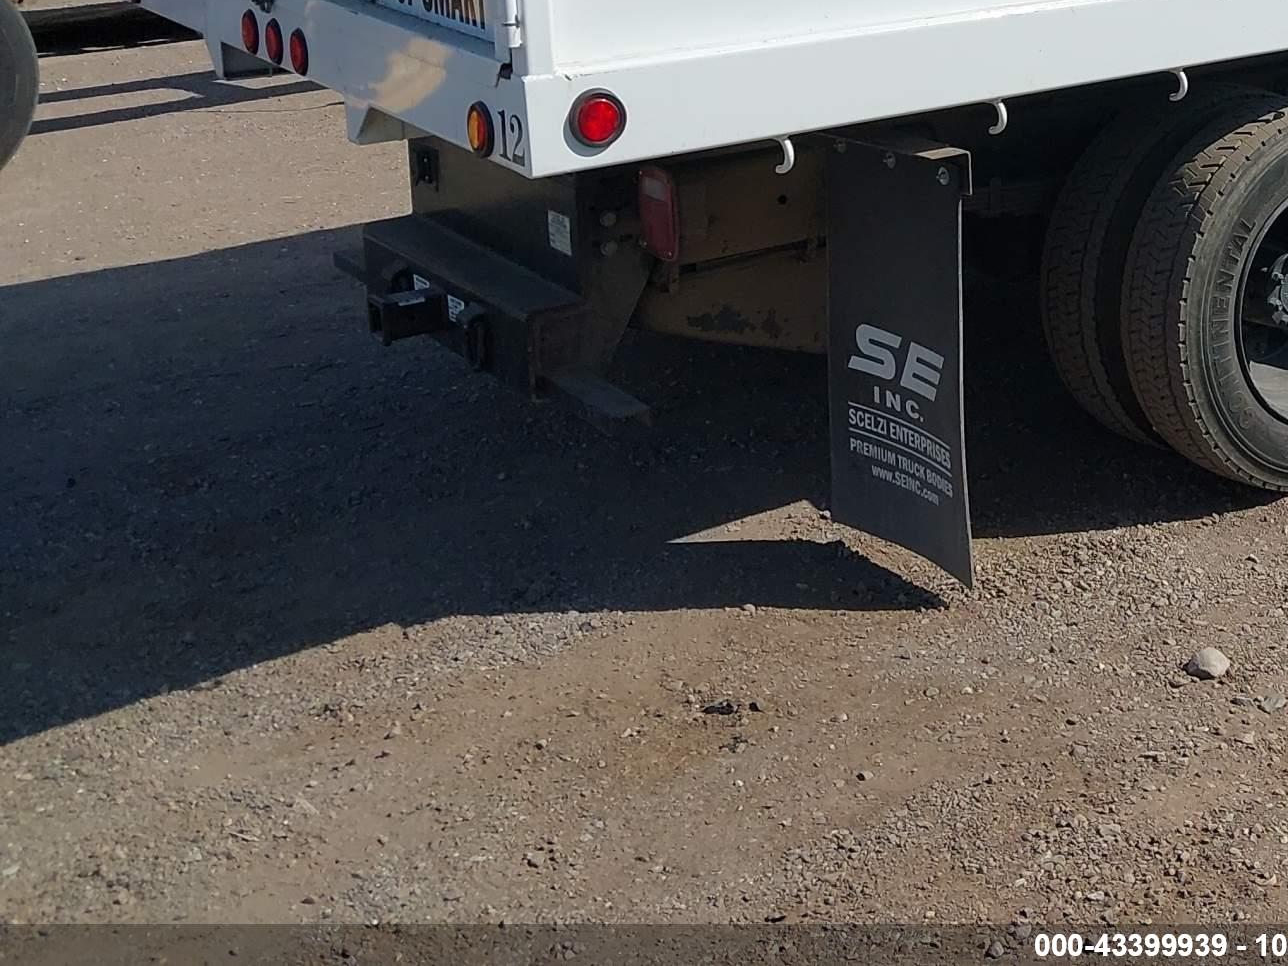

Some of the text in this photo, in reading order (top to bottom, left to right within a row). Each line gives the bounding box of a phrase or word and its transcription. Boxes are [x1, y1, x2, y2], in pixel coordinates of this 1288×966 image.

[497, 110, 526, 167] 12
[848, 324, 945, 402] SE
[873, 386, 925, 422] INC.
[849, 408, 951, 470] SCELZI ENTERPRISES
[850, 437, 954, 498] PREMIUM TRUCK BODIES
[872, 465, 940, 507] www.SEINC.com
